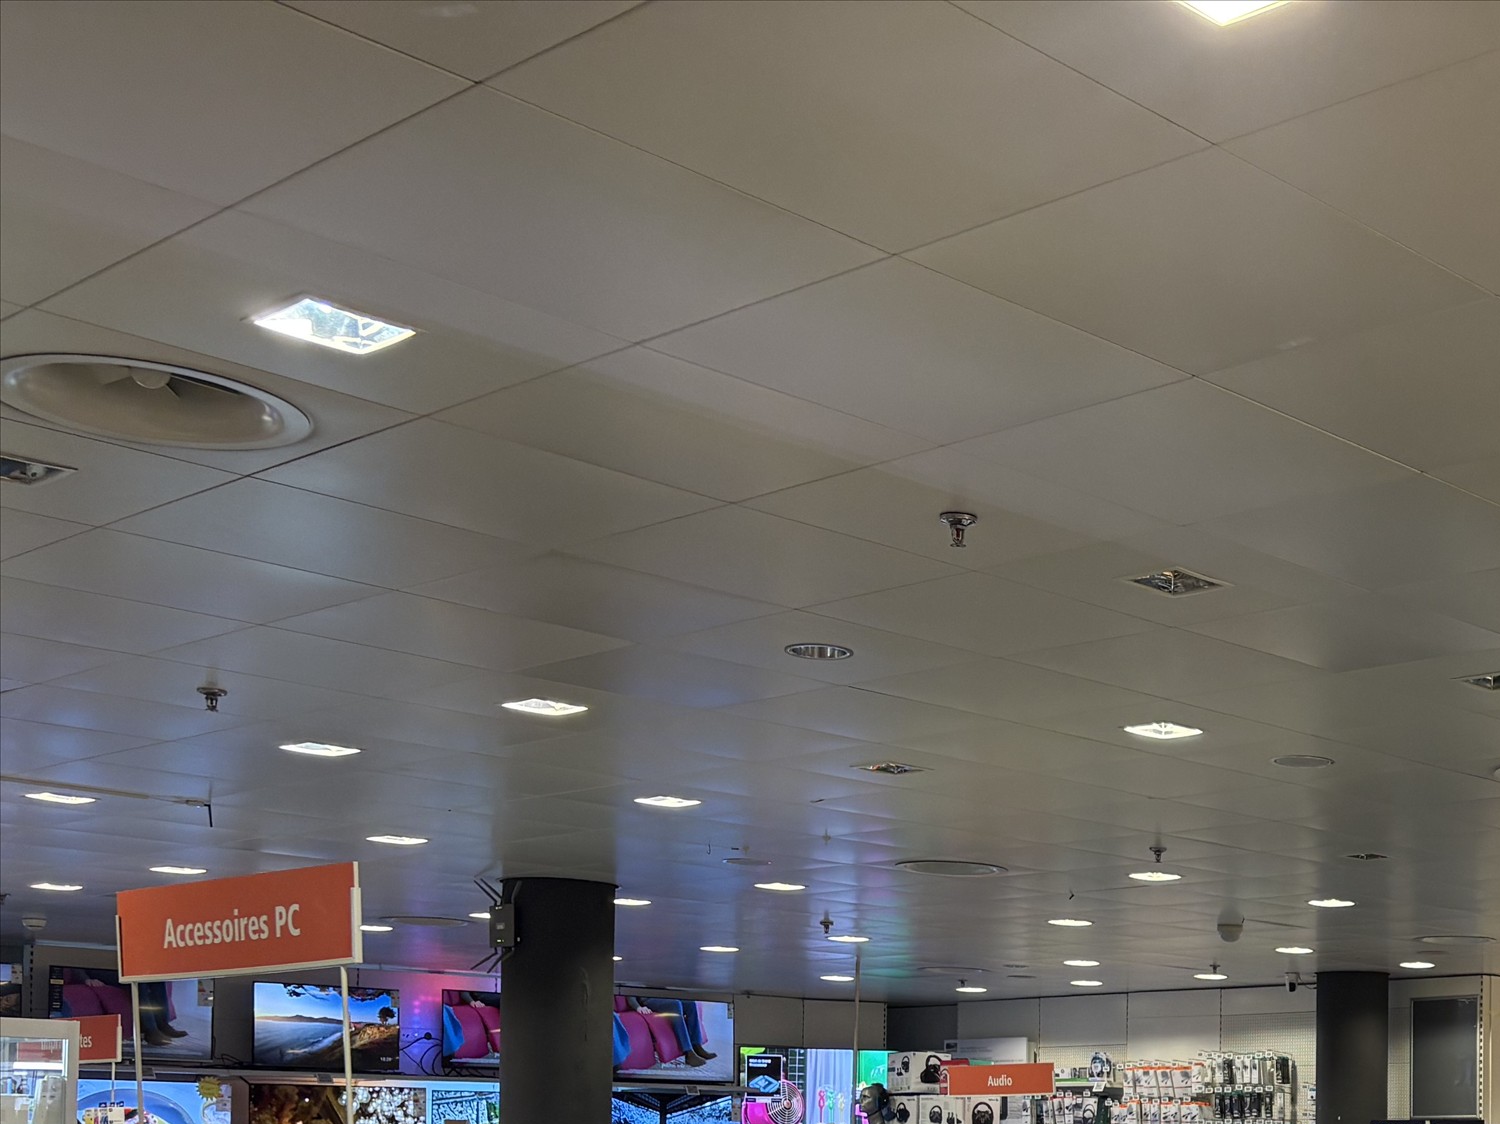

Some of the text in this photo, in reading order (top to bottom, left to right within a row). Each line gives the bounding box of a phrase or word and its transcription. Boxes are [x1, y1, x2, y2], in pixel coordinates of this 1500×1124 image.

[163, 904, 301, 949] Accessoires PC
[987, 1075, 1013, 1087] Audio
